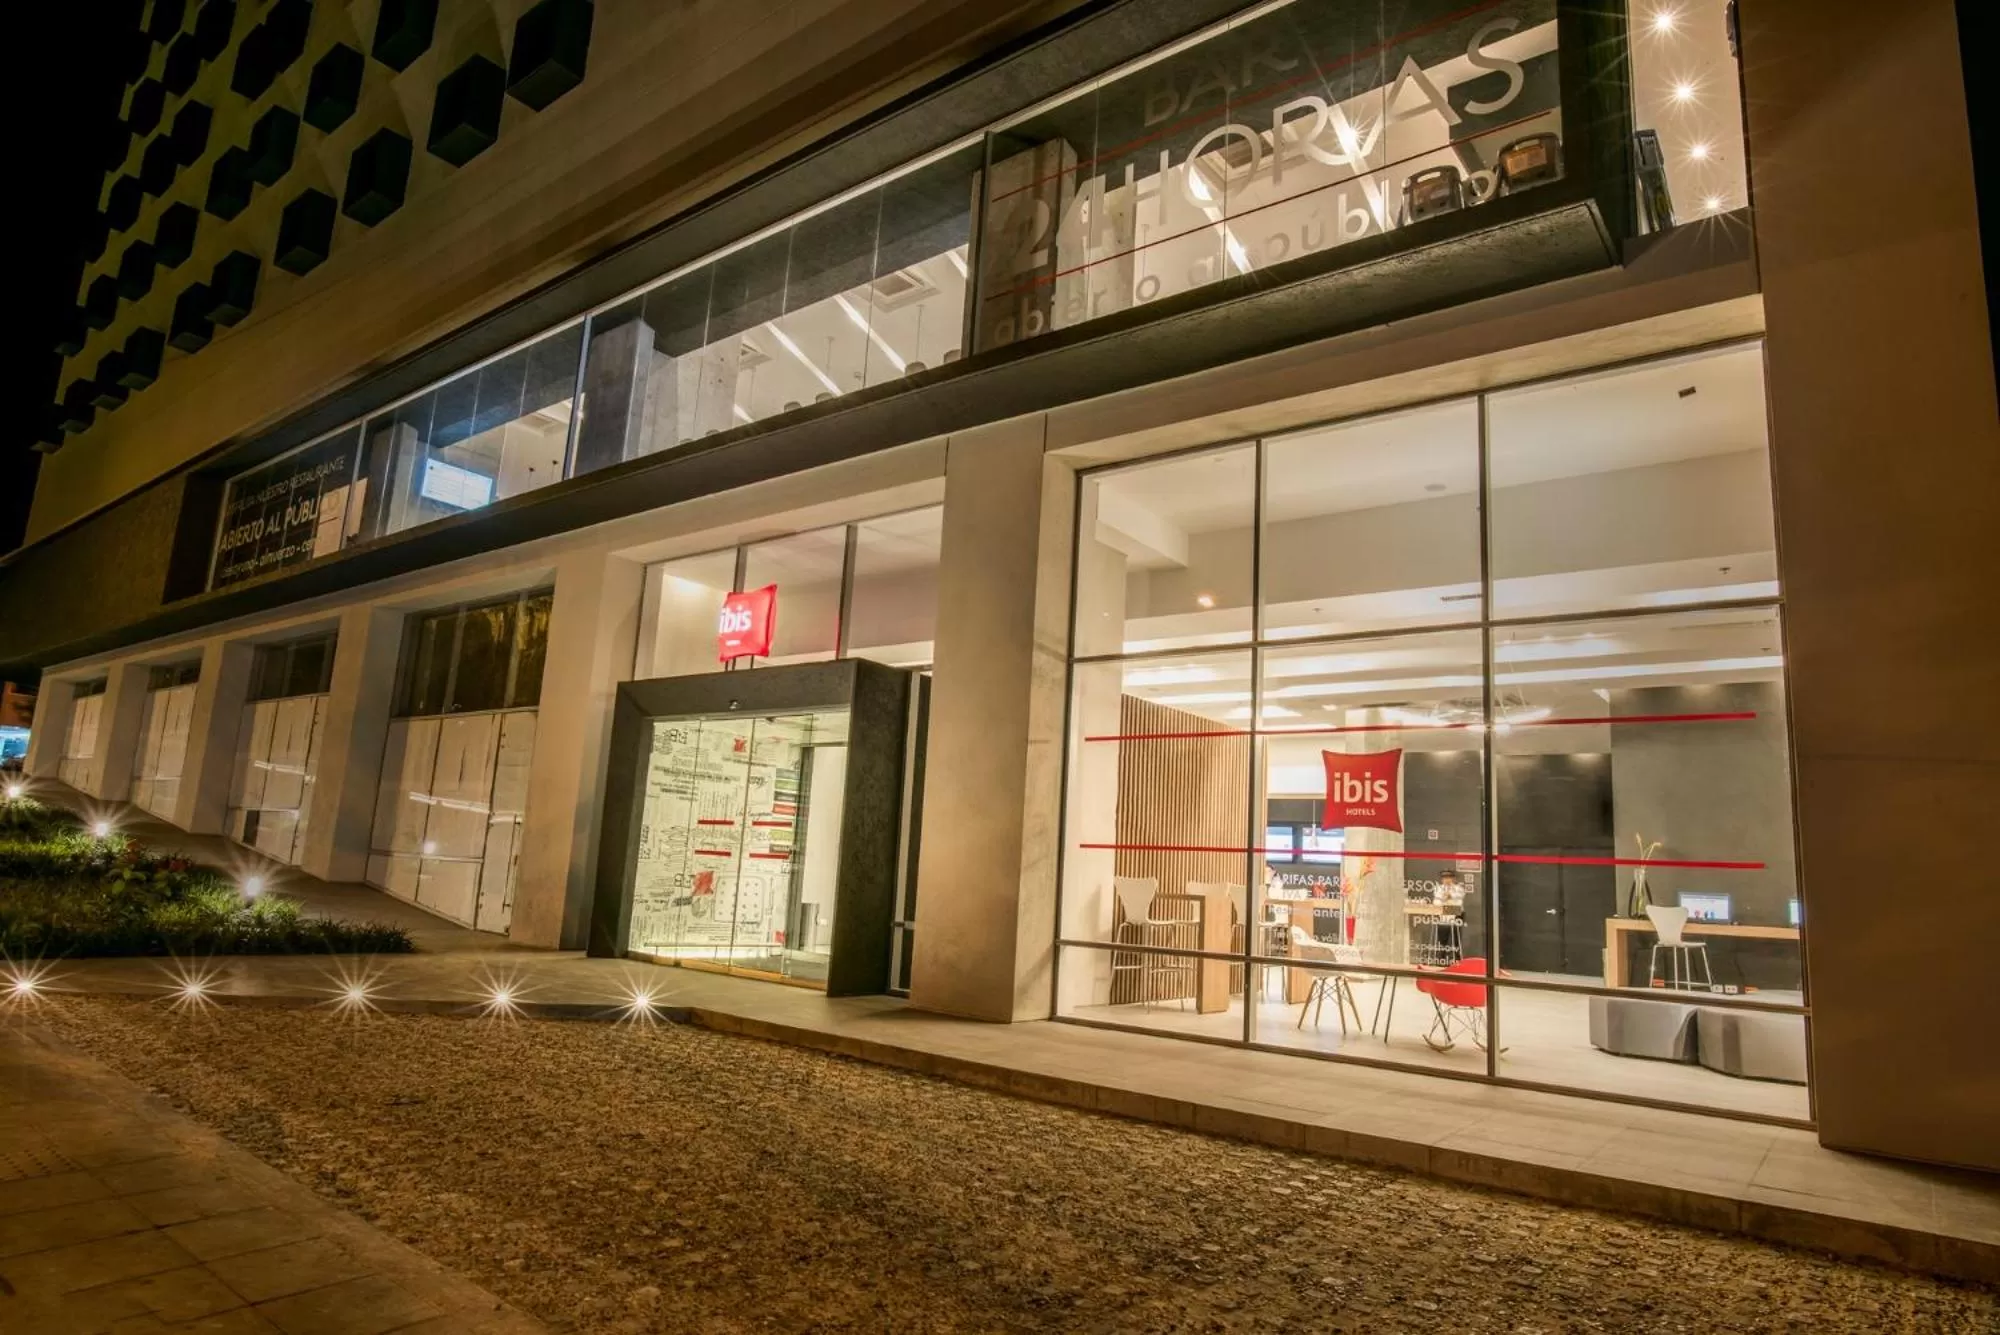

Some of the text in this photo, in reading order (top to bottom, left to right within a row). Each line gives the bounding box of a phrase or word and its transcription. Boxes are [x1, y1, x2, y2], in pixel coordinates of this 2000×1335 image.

[219, 517, 265, 551] ABIERTO
[265, 512, 281, 536] AL
[719, 604, 753, 634] ibis
[1334, 771, 1389, 804] ibis
[1345, 807, 1377, 817] HOTELS
